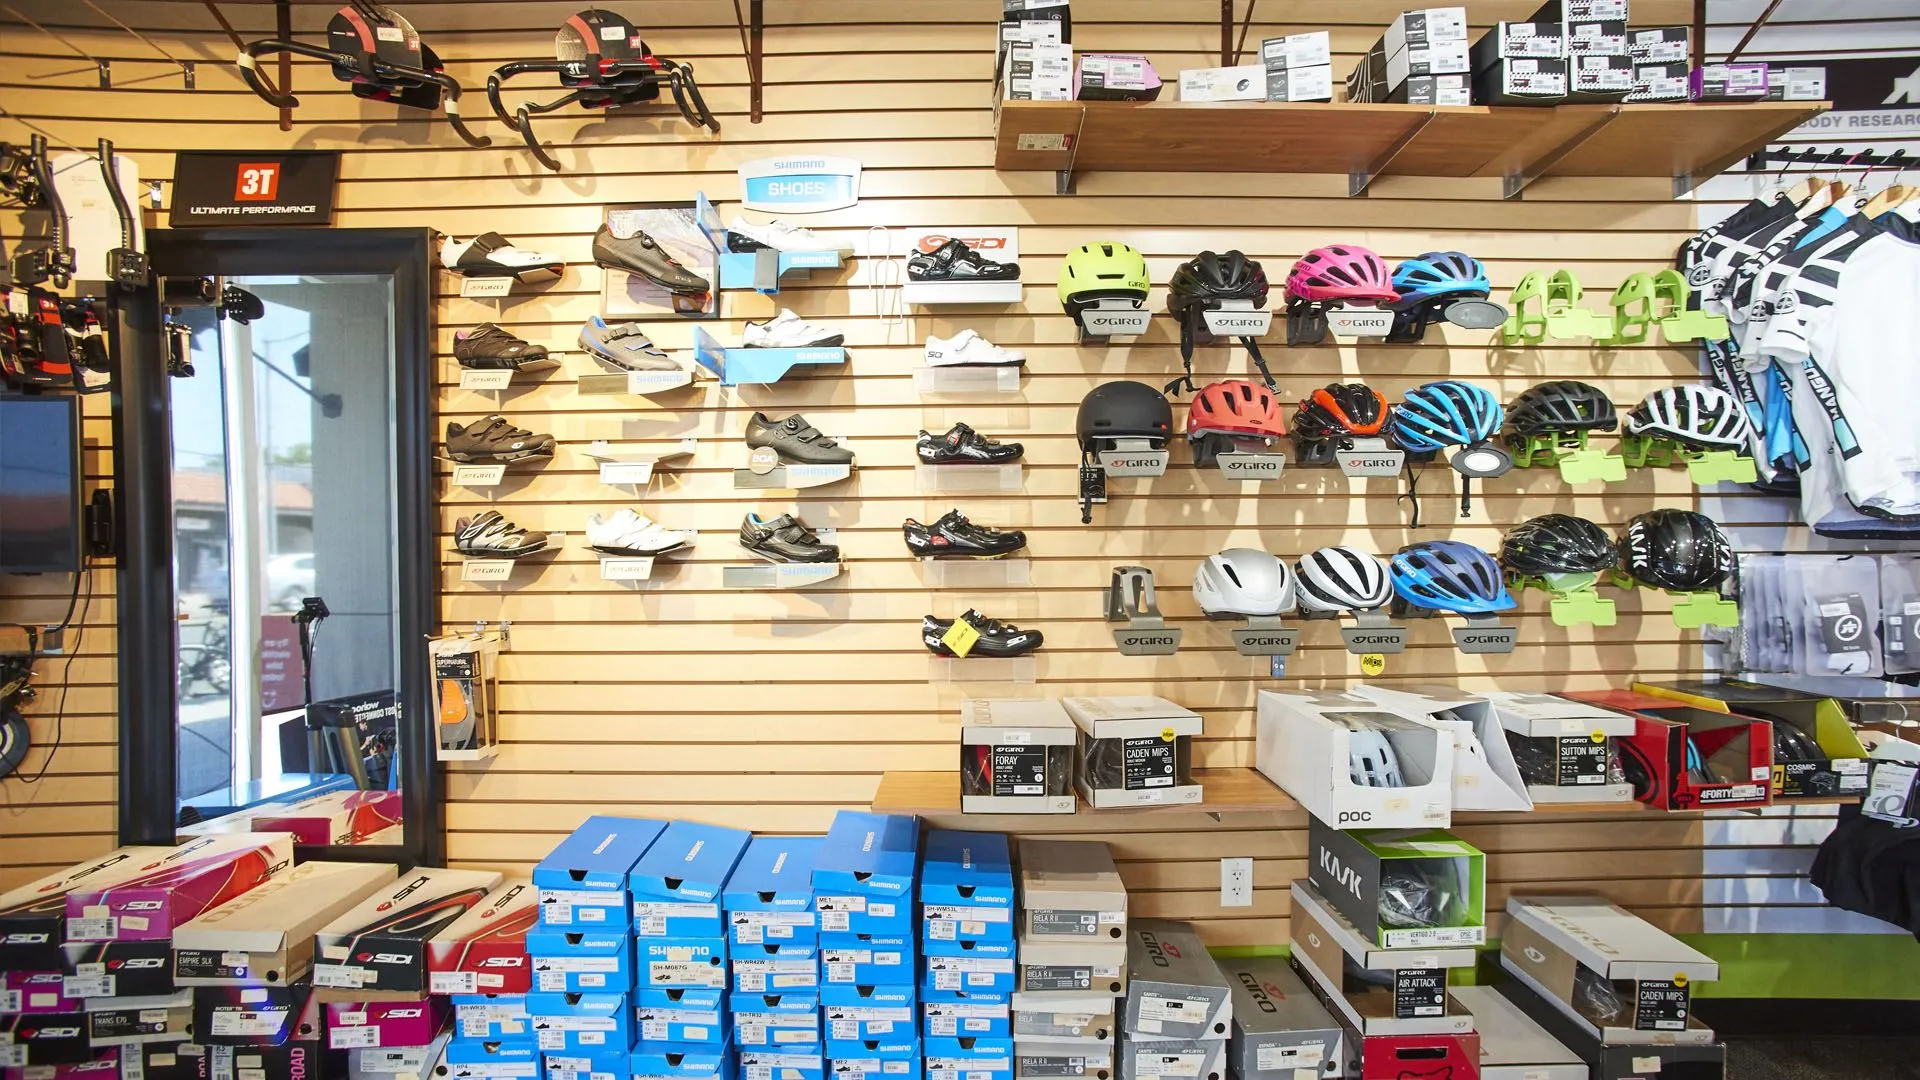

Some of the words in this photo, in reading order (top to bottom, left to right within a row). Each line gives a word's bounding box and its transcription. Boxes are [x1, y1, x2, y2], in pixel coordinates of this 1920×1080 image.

[774, 160, 826, 170] SHIMANO
[241, 169, 274, 195] 3T
[768, 181, 826, 197] SHOES
[190, 206, 241, 215] ULTIMATE
[241, 205, 317, 214] PERFORMANCE
[790, 254, 836, 266] SHIMANO
[1108, 318, 1143, 326] GIRO
[1230, 319, 1264, 327] GIRO
[1352, 319, 1386, 327] GIRO
[1126, 459, 1160, 467] GIRO
[1243, 462, 1277, 470] GIRO
[1363, 459, 1396, 467] GIRO
[1139, 637, 1174, 645] GIRO
[1257, 637, 1291, 646] GIRO
[1367, 636, 1400, 644] GIRO
[1477, 635, 1510, 643] GIRO
[1126, 748, 1150, 759] CADEN
[1152, 747, 1169, 757] MIPS
[1561, 746, 1587, 756] SUTTON
[1588, 746, 1605, 755] MIPS
[995, 755, 1018, 765] FORAY
[1786, 763, 1816, 771] COSMIC
[1700, 788, 1733, 799] 4FORTY
[1339, 809, 1372, 825] poc
[1320, 845, 1362, 900] KASK
[393, 876, 430, 902] SIDI
[585, 880, 617, 889] SHIMANO
[869, 881, 901, 889] SHIMANO
[494, 885, 526, 908] SIDI
[680, 888, 712, 898] SHIMANO
[127, 900, 164, 911] SIDI
[6, 933, 50, 944] SIDI
[1386, 933, 1392, 948] L
[1140, 931, 1170, 968] GIRO
[124, 958, 165, 969] SIDI
[179, 957, 200, 965] EMPIRE
[201, 957, 213, 965] SLX
[374, 953, 414, 965] SIDI
[484, 956, 524, 967] SIDI
[1398, 978, 1410, 988] AIR
[1411, 977, 1436, 988] ATTACK
[1238, 972, 1277, 1013] GIRO
[1640, 990, 1664, 1001] CADEN
[1666, 991, 1684, 1001] MIPS
[583, 1002, 614, 1010] SHIMANO
[386, 1008, 423, 1018] SIDI
[95, 1017, 114, 1025] TRANS
[36, 1027, 81, 1038] SIDI
